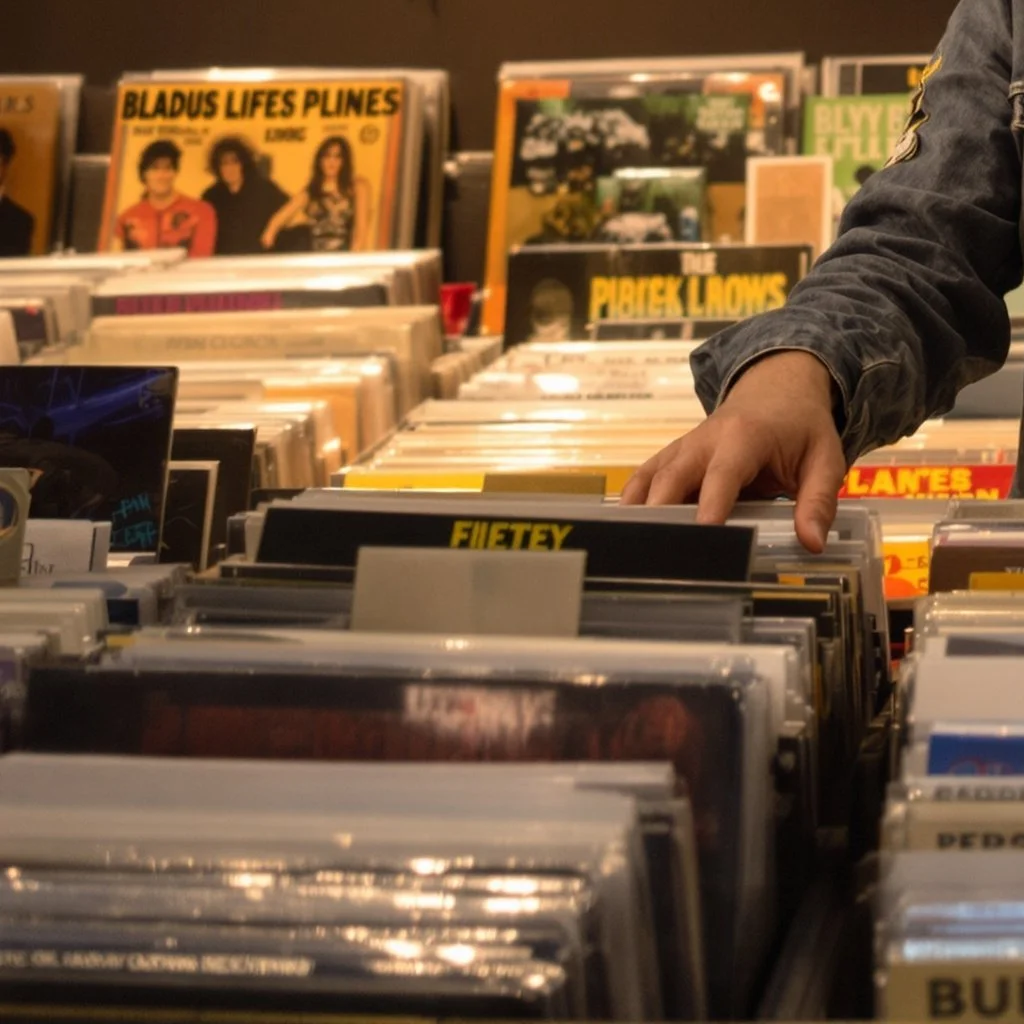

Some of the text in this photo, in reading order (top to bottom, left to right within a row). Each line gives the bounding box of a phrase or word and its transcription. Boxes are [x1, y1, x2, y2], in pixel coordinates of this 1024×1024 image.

[121, 86, 402, 121] BLADUS LIFES PLINES
